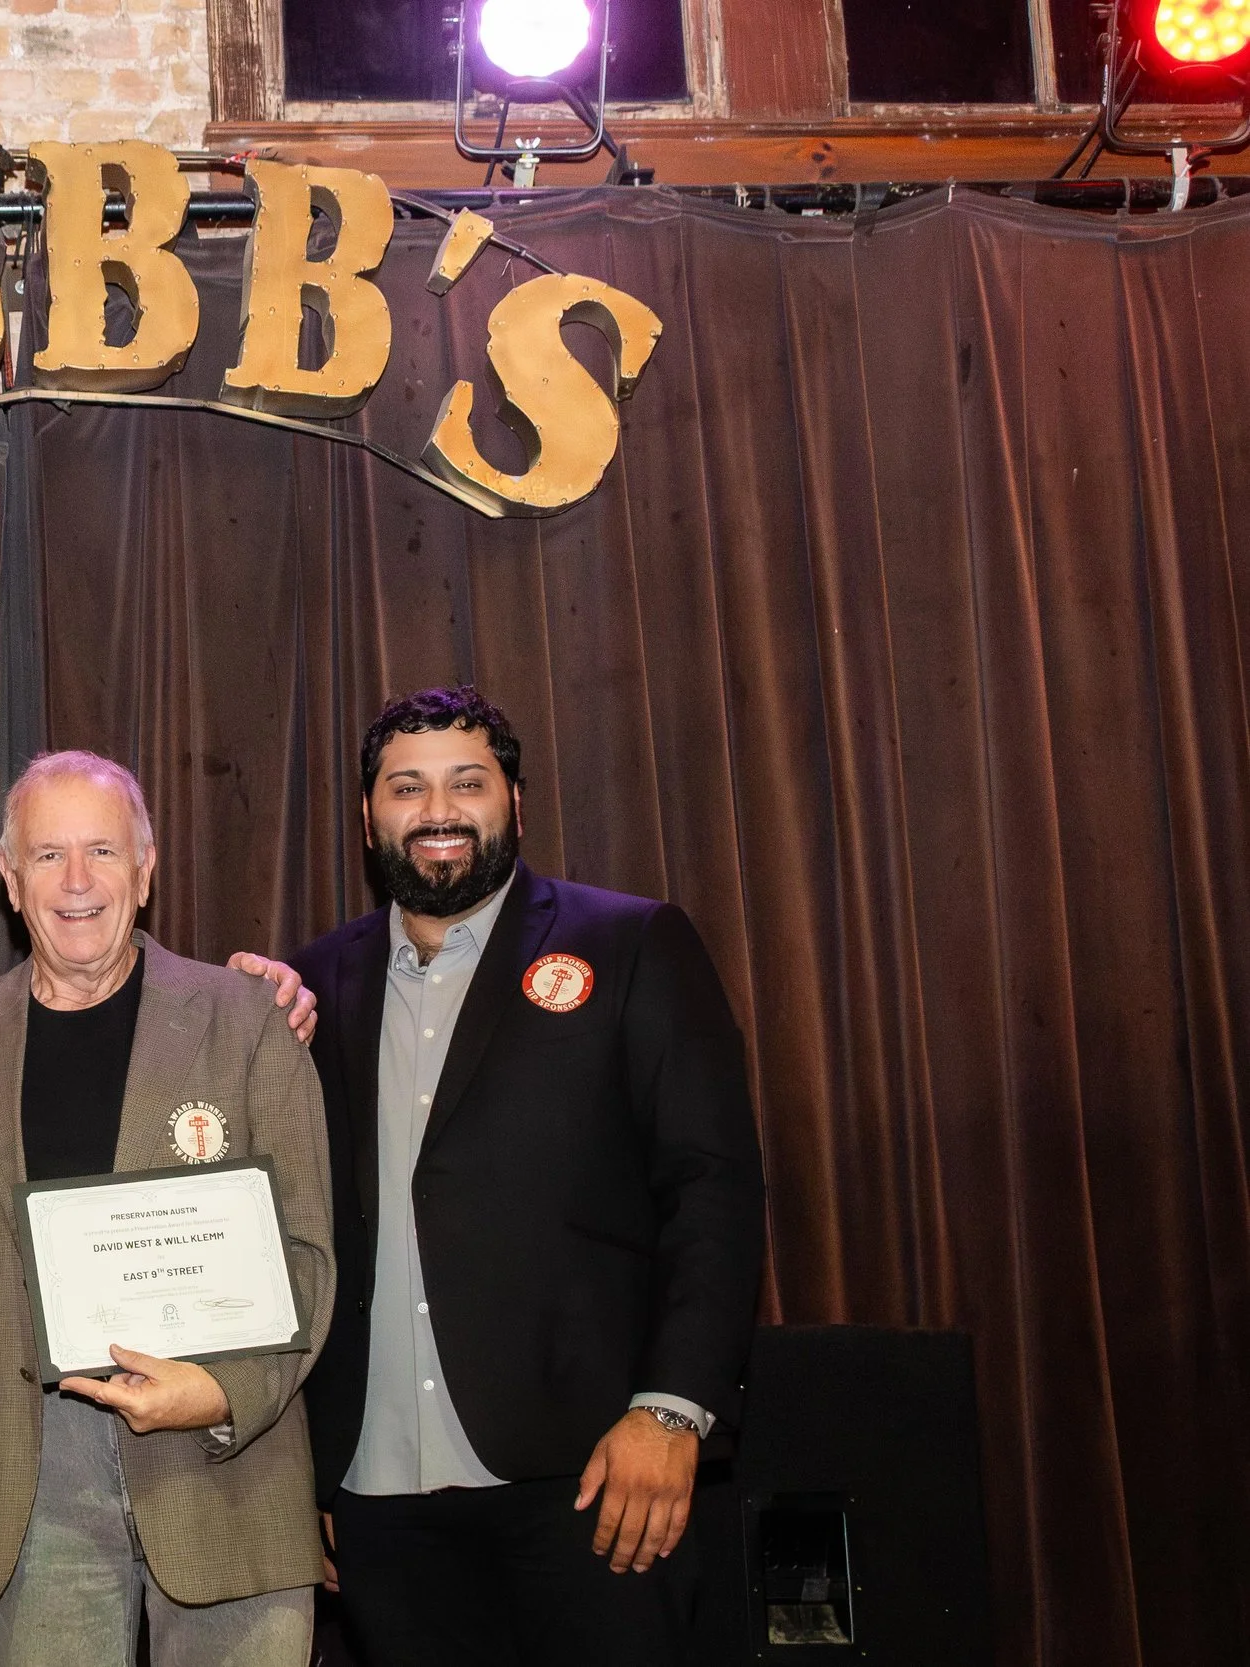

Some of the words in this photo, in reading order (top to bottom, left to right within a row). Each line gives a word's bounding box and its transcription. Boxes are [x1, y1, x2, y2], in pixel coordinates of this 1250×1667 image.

[536, 957, 552, 967] VIP
[556, 956, 590, 978] SPONSOR
[526, 988, 538, 1000] VIP
[538, 999, 581, 1011] SPONSOR
[168, 1102, 194, 1126] AWARD
[197, 1100, 227, 1126] WINNER
[170, 1143, 200, 1164] AWARD
[110, 1210, 168, 1220] PRESERVATION
[170, 1206, 198, 1216] AUSTIN
[93, 1242, 122, 1252] DAVID
[124, 1239, 152, 1249] WEST
[155, 1238, 162, 1246] &
[164, 1236, 189, 1245] WILL
[190, 1232, 224, 1242] KLEMM
[123, 1270, 149, 1282] EAST
[151, 1268, 164, 1279] 9TH
[166, 1265, 204, 1277] STREET
